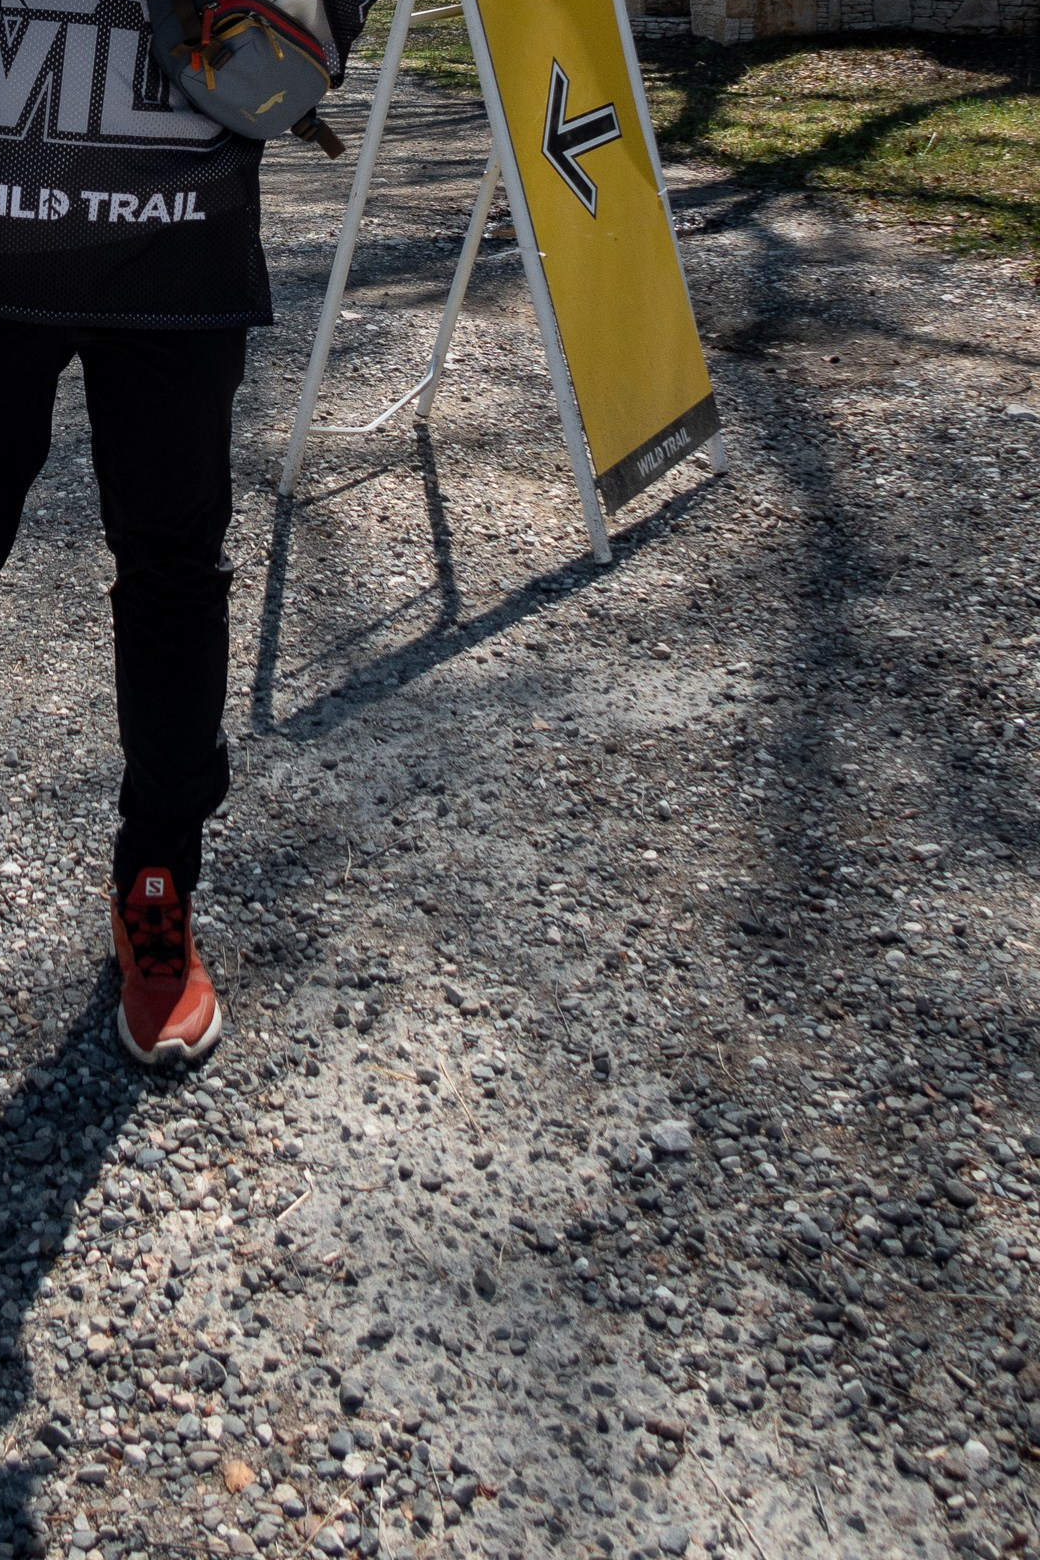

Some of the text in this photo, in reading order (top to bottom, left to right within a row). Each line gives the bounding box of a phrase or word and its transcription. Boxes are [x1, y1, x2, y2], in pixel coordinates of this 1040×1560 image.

[81, 190, 206, 223] TRAIL
[636, 427, 692, 478] WILD TRAIL
